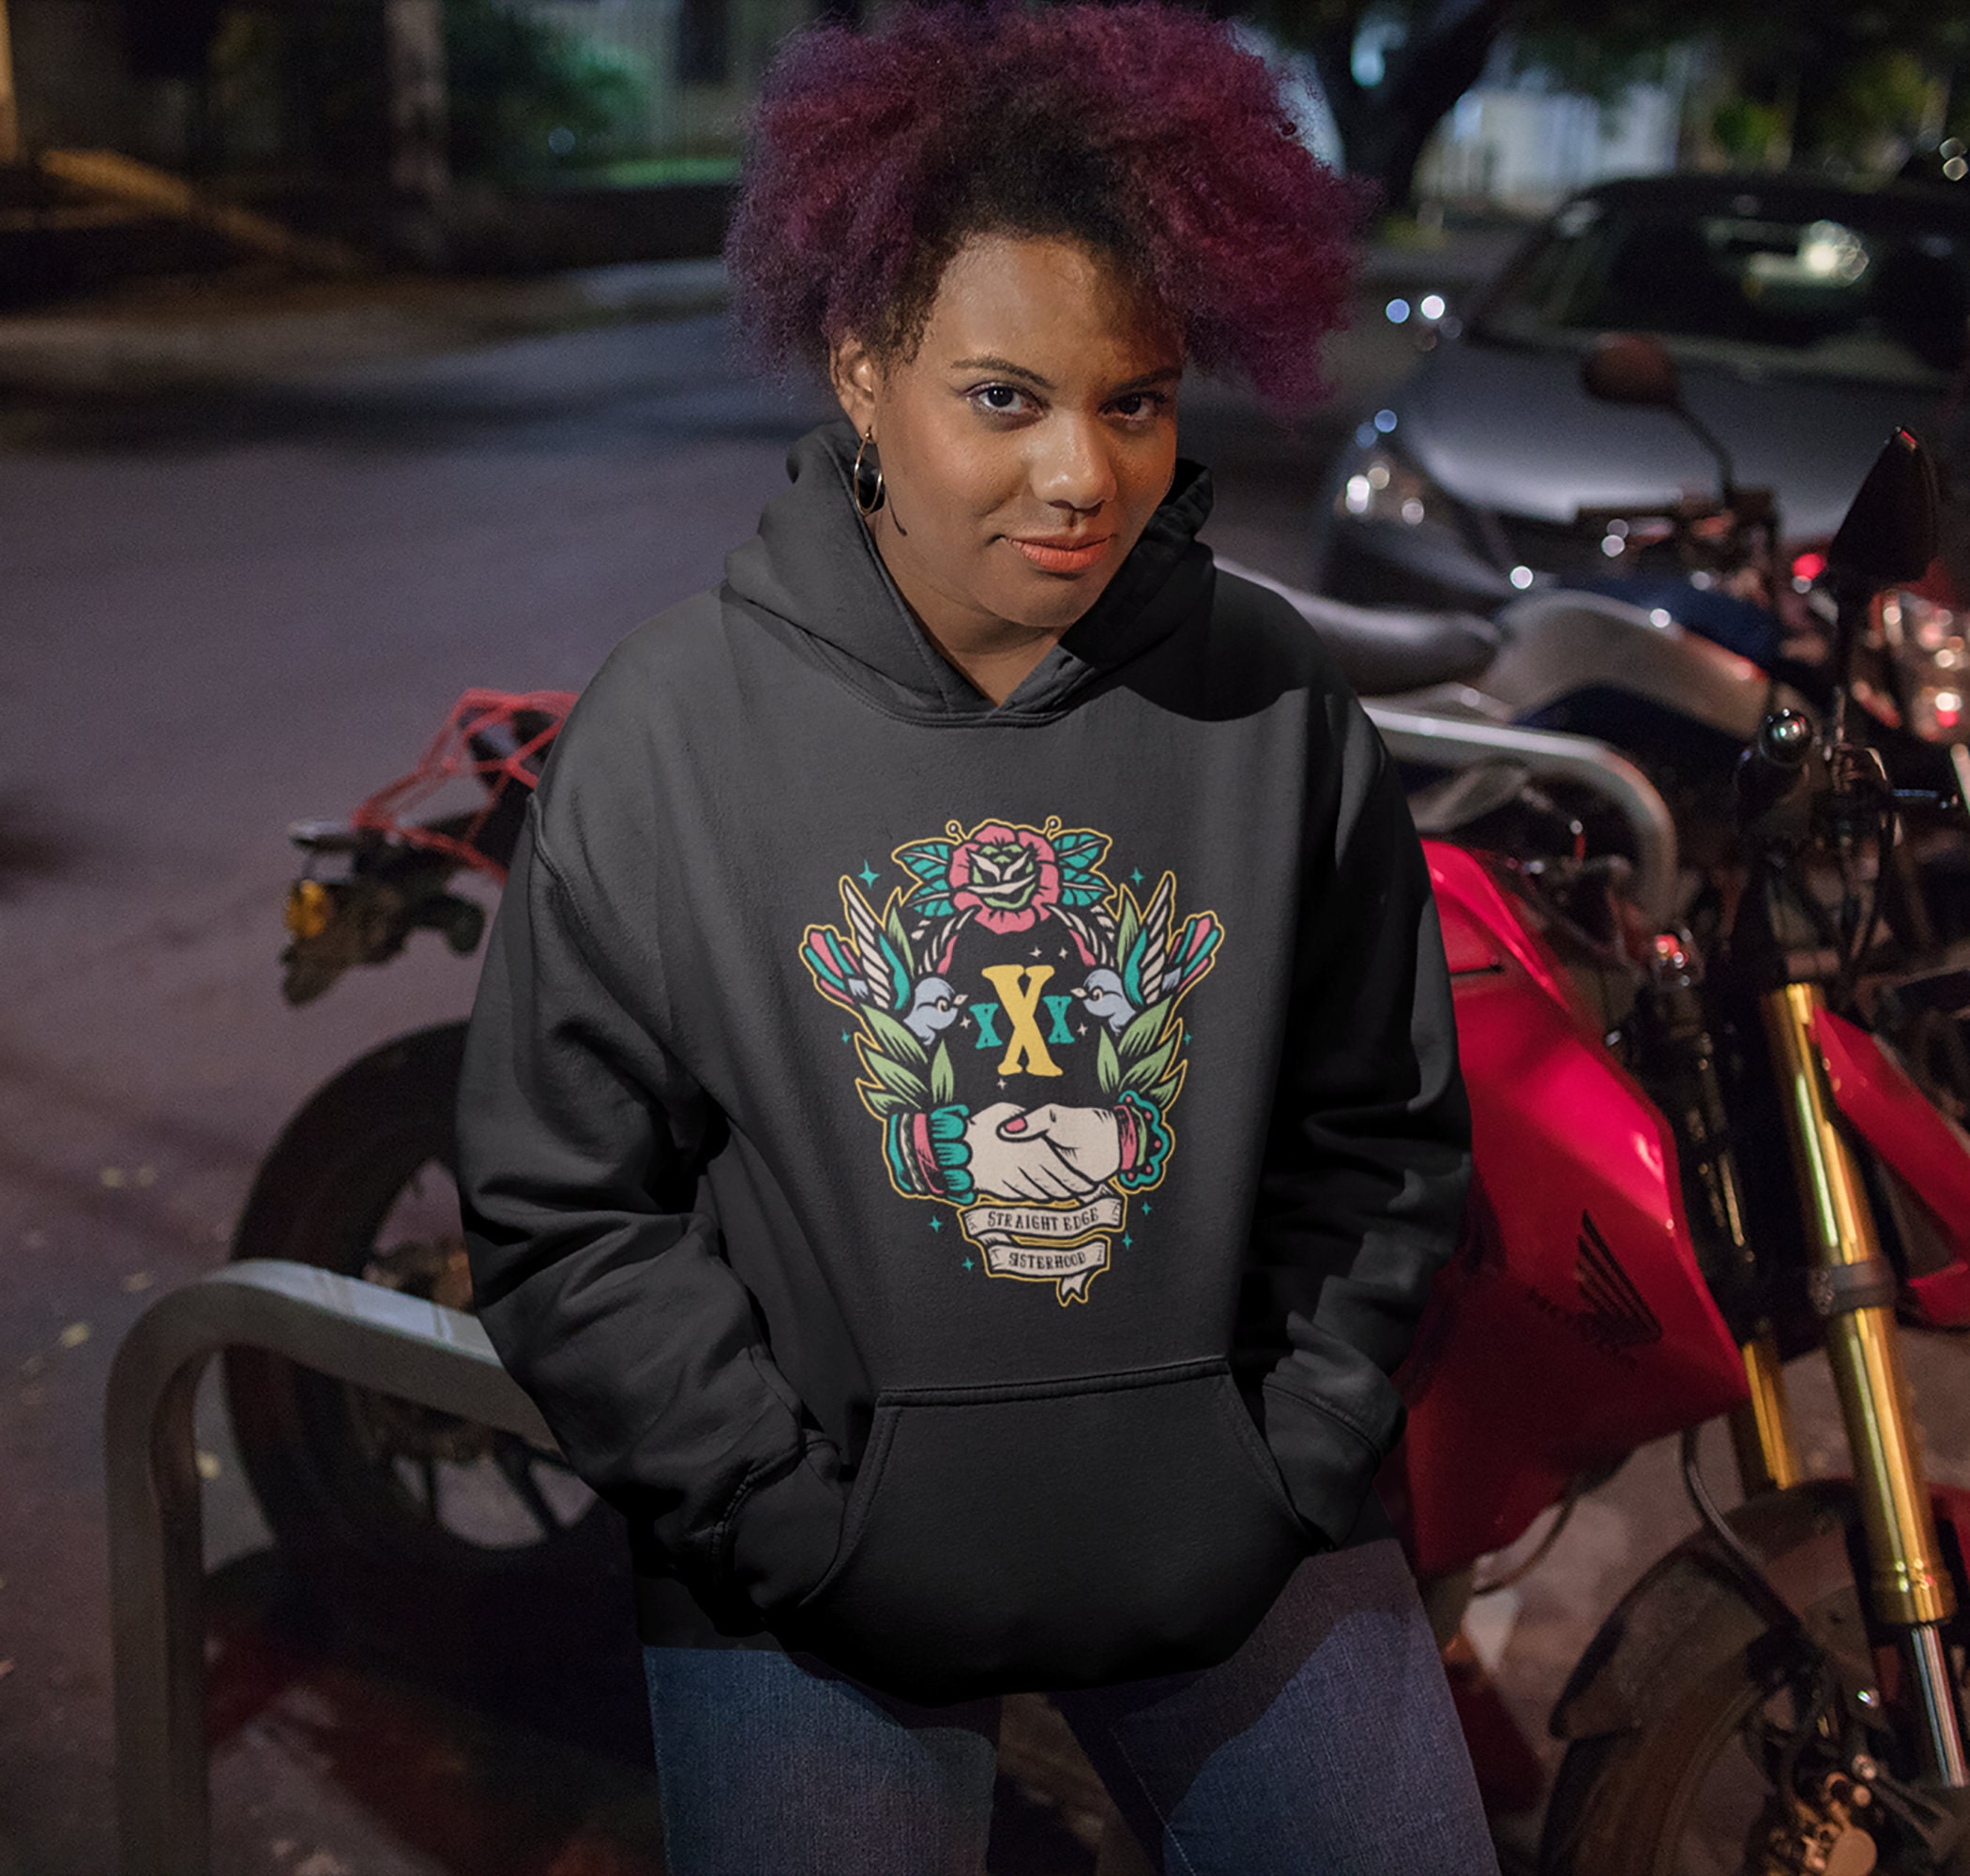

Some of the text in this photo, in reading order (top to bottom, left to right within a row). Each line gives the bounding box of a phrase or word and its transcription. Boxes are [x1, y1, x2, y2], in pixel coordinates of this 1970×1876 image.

[987, 1208, 1099, 1232] STRAIGHT EDGE
[1008, 1252, 1086, 1269] SISTERHOOD
